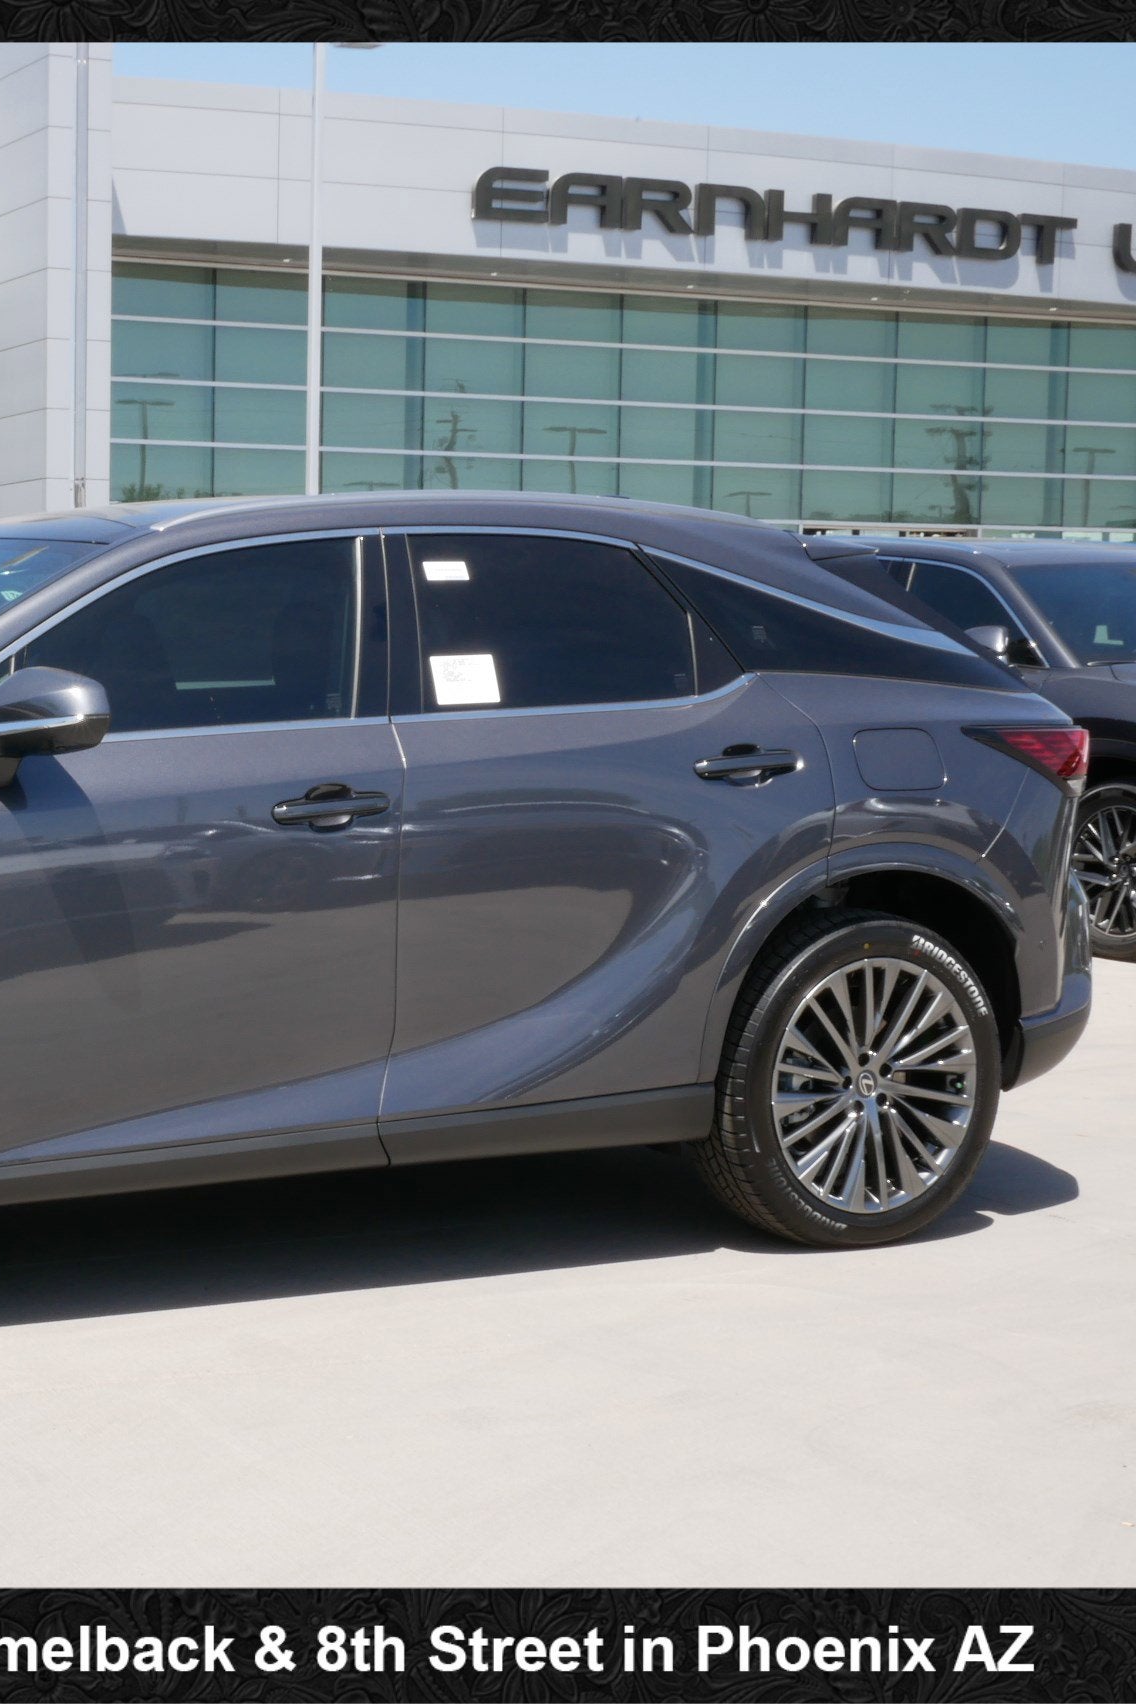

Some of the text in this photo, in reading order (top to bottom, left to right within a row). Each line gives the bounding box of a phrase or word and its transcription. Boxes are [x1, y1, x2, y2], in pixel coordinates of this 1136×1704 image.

[471, 165, 1078, 264] EARNHARDT
[911, 935, 988, 1016] BRIDGESTONE
[768, 1158, 848, 1233] BRIDGESTONE
